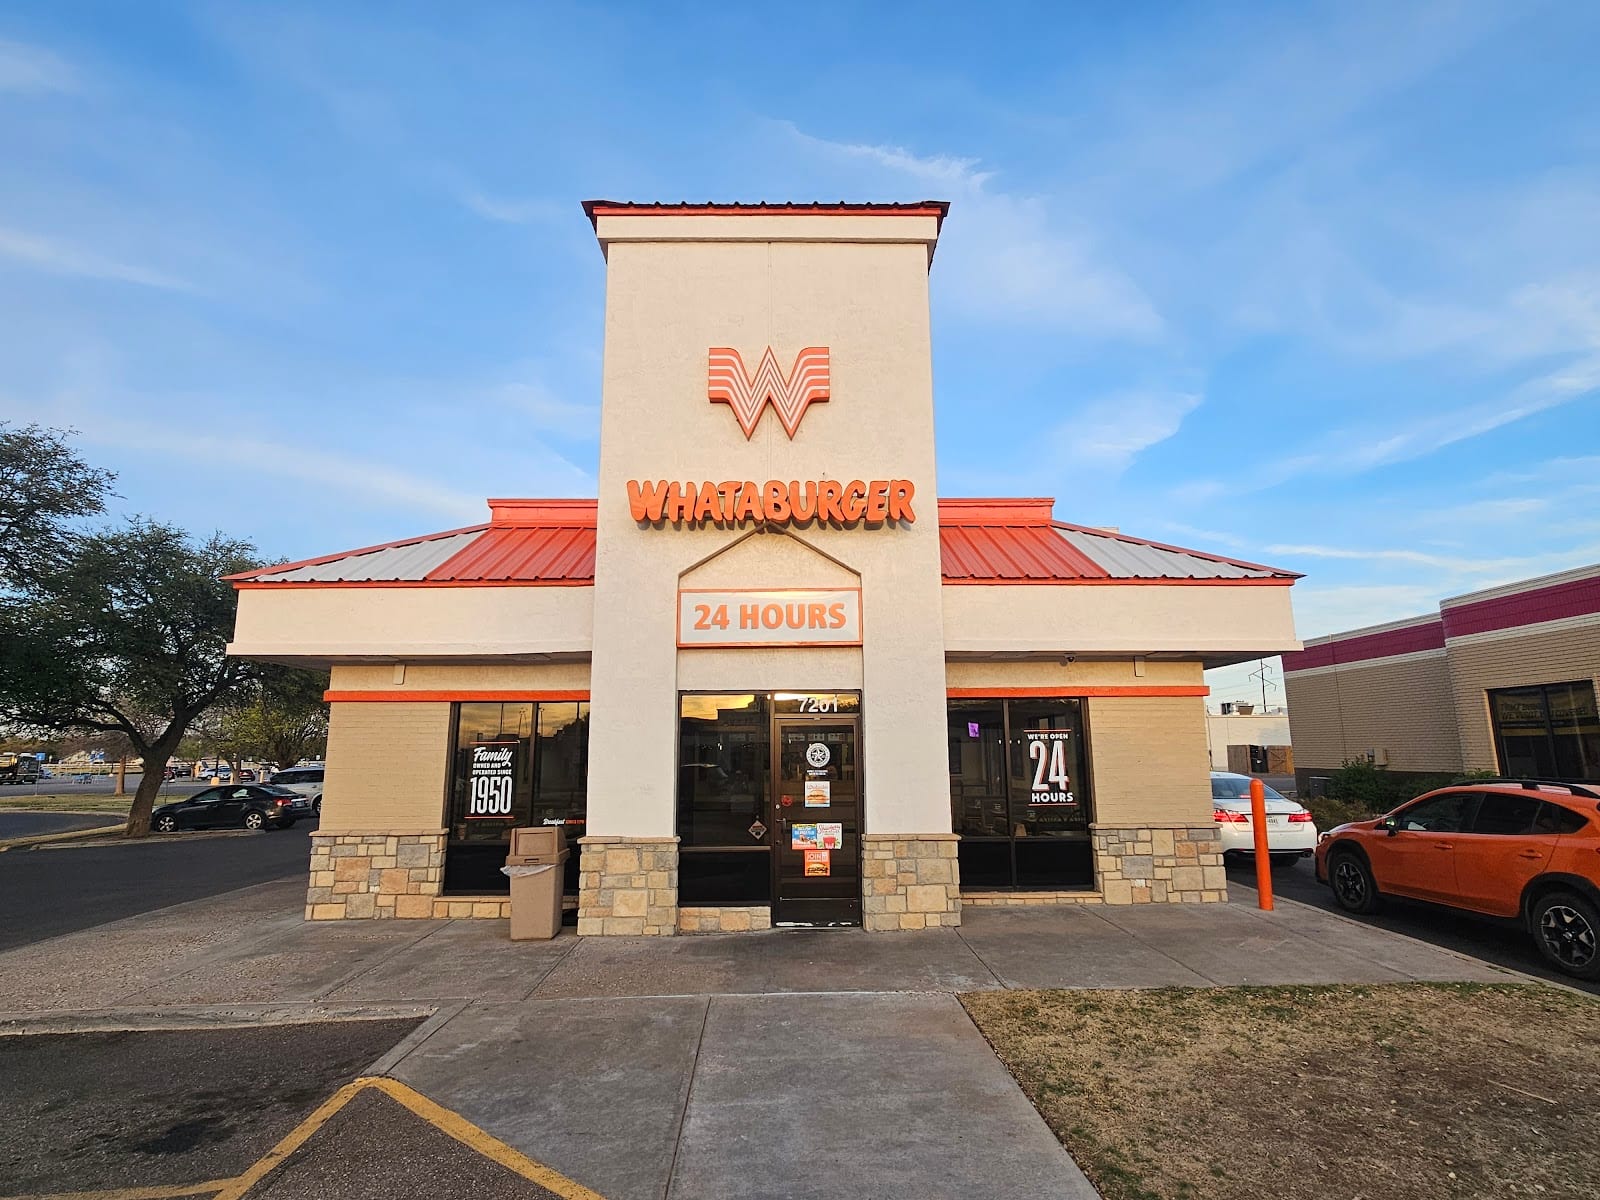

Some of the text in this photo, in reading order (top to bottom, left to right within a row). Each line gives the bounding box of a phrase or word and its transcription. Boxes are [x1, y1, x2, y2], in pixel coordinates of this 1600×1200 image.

[627, 480, 916, 525] WHATABURGER
[694, 604, 846, 630] 24 HOURS
[798, 696, 838, 713] 7201
[474, 747, 513, 767] Family
[1030, 740, 1070, 791] 24
[470, 776, 513, 814] 1950
[1032, 792, 1074, 802] HOURS
